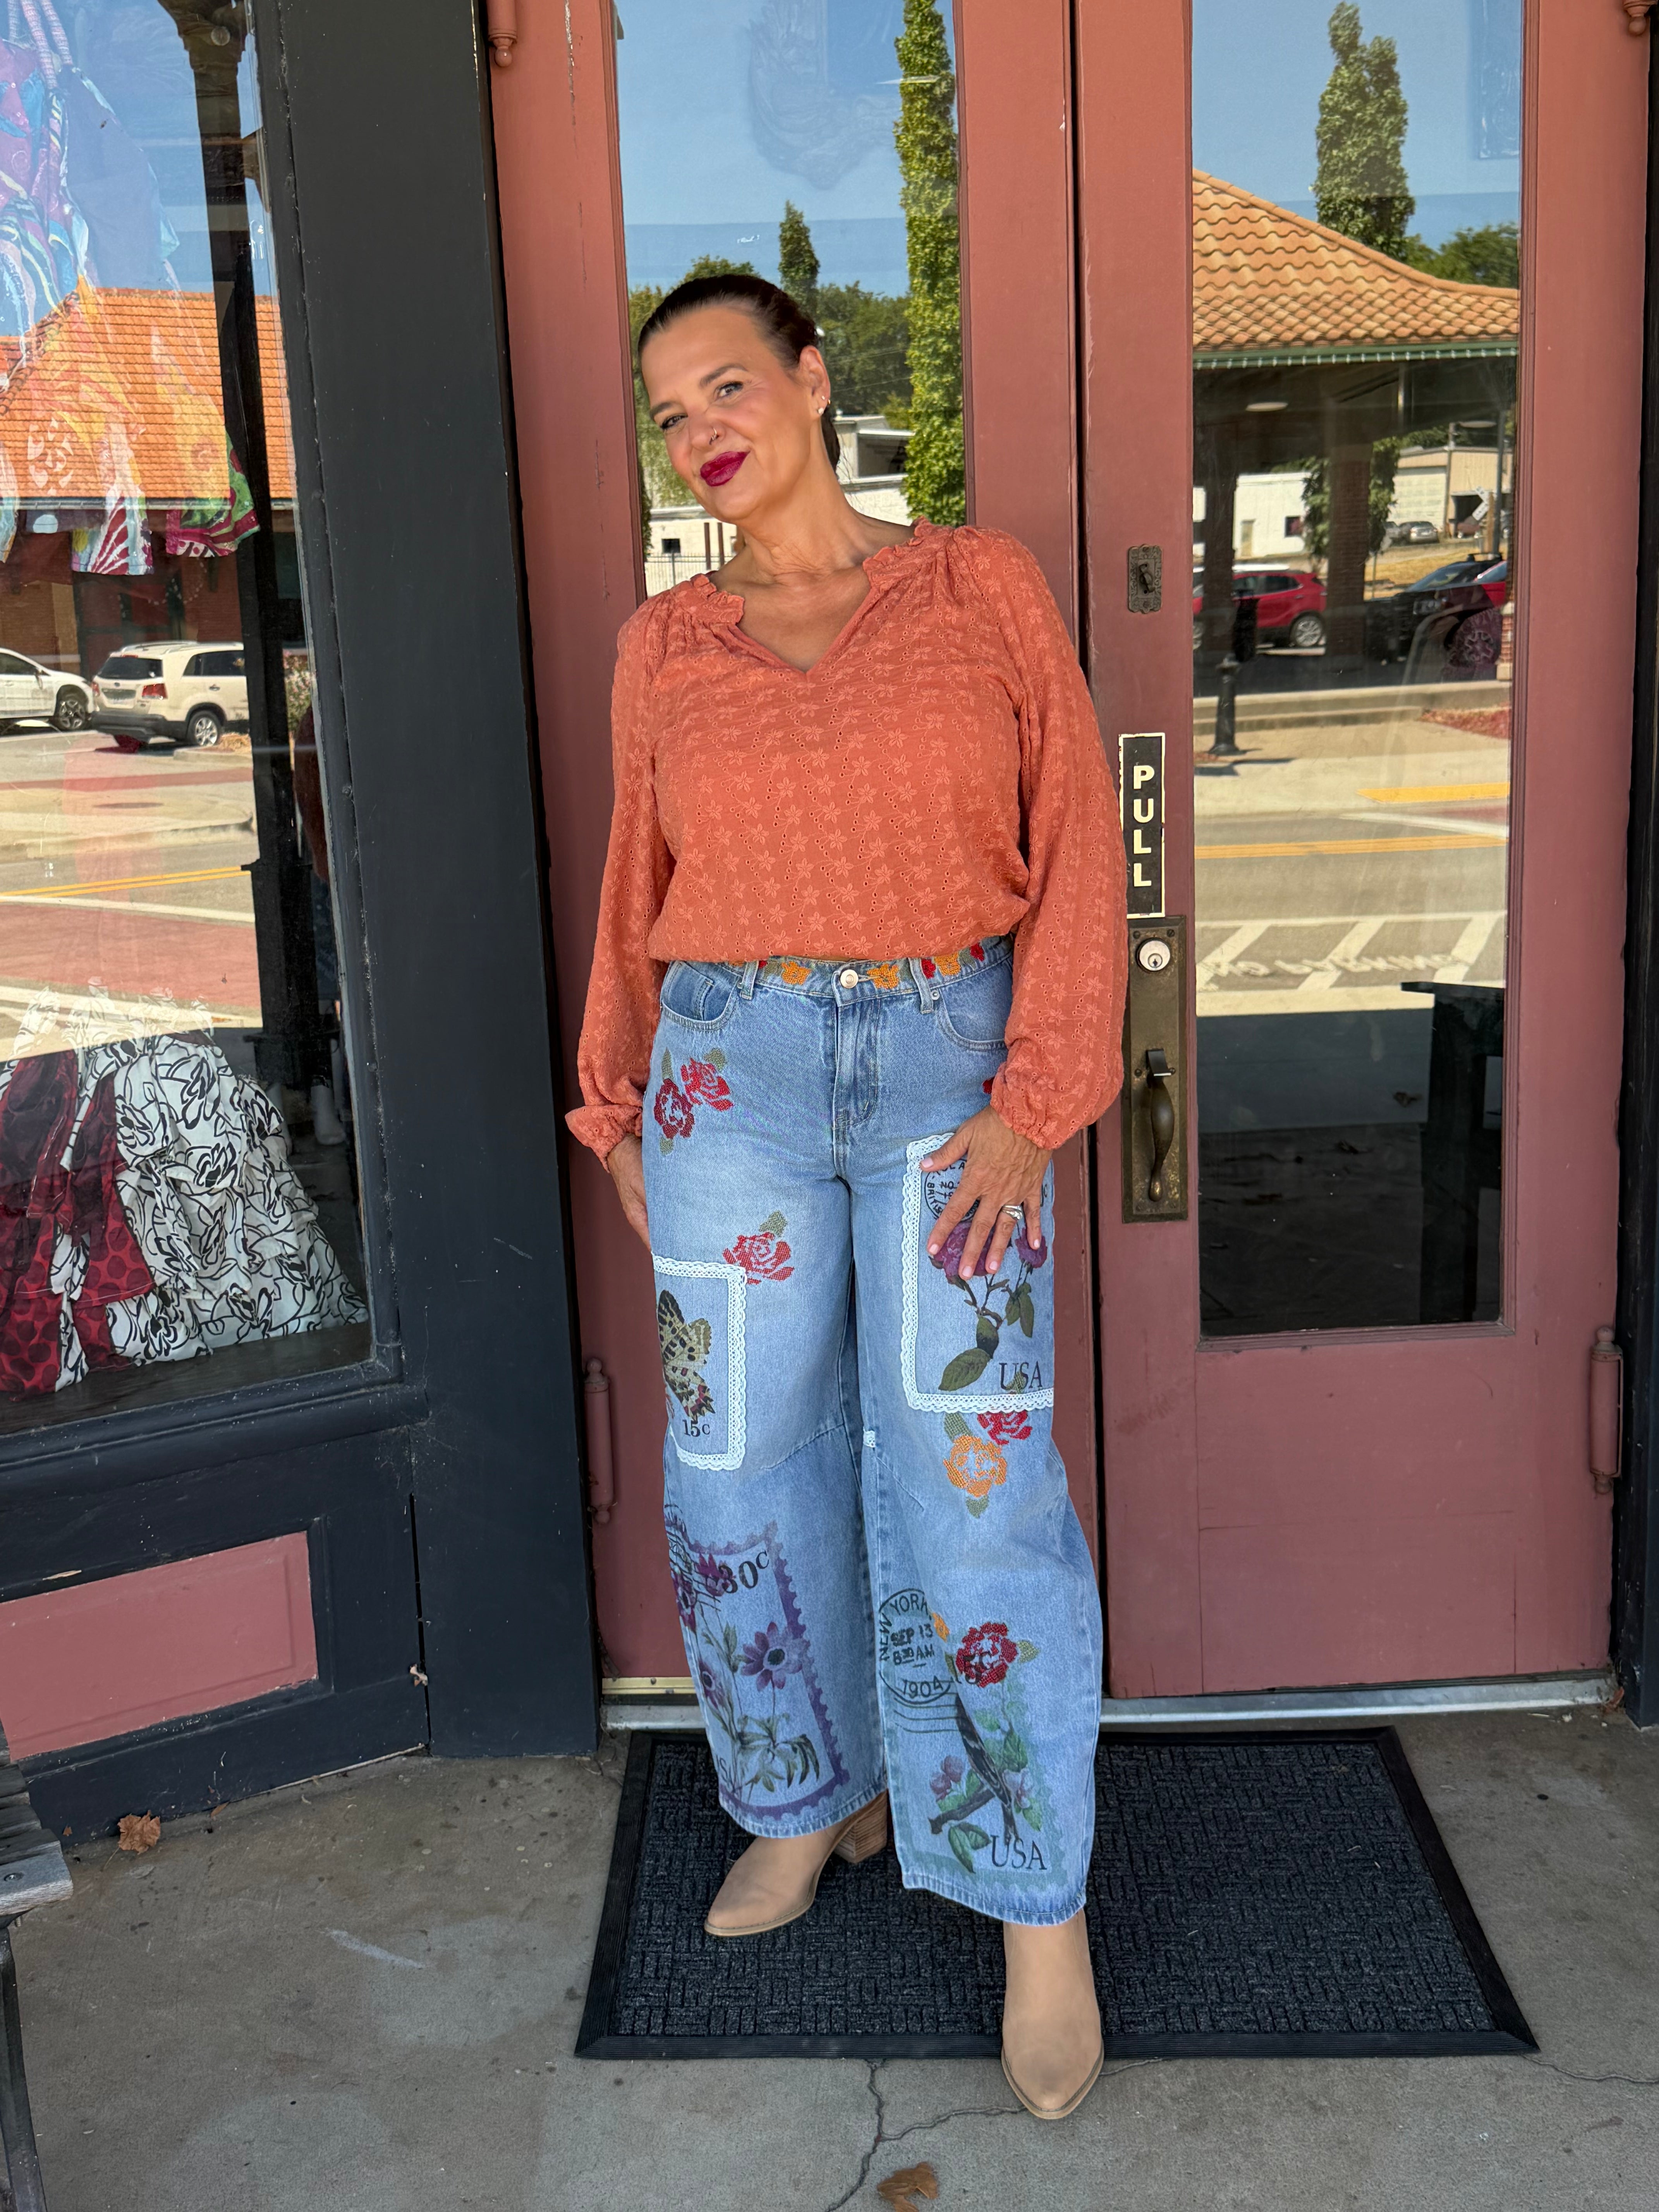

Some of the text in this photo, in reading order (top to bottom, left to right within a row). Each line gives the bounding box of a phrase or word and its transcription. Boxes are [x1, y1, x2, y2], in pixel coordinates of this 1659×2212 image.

[1133, 765, 1155, 887] PULL
[999, 1360, 1043, 1391] USA
[682, 1419, 710, 1437] 15c
[902, 1675, 943, 1699] 1904
[990, 1834, 1048, 1870] USA
